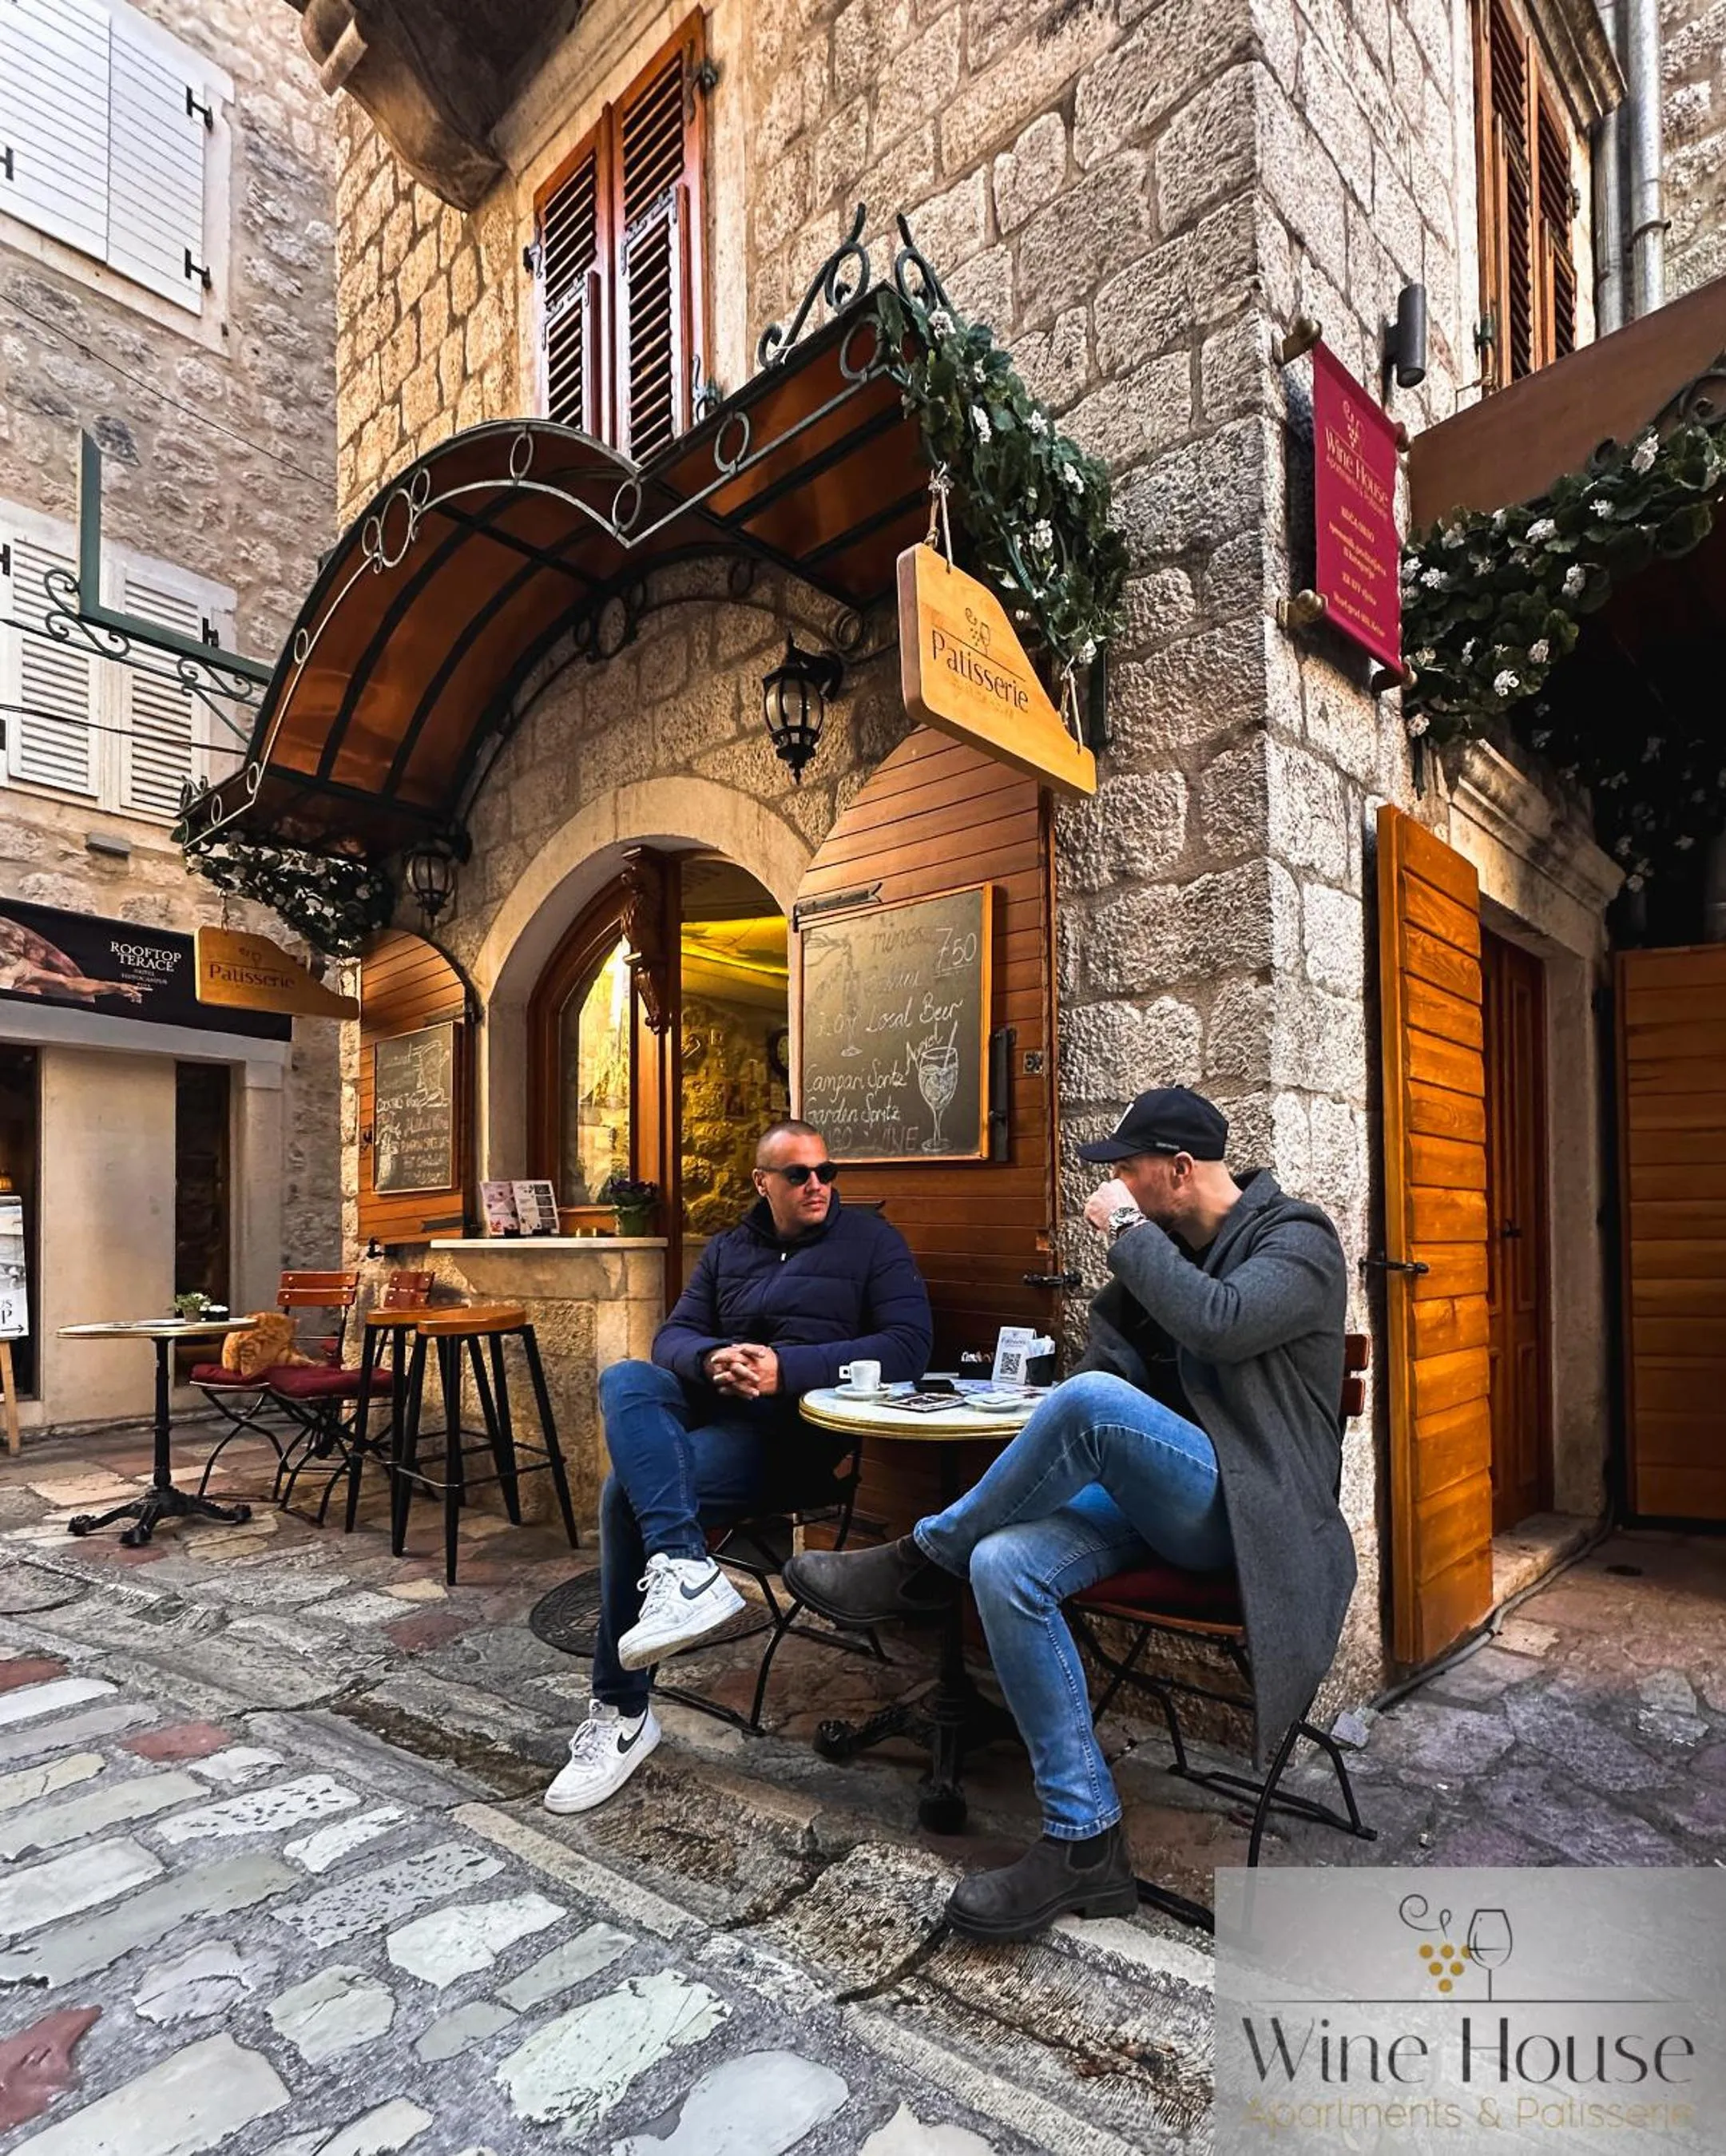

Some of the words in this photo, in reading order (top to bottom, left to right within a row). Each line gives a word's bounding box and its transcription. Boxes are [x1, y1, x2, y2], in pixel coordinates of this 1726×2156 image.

[1326, 427, 1353, 474] Wine
[1355, 458, 1388, 508] House
[932, 629, 1029, 713] Patisserie
[110, 941, 182, 963] ROOFTOP
[117, 951, 174, 972] TERACE
[209, 963, 296, 988] Patisserie
